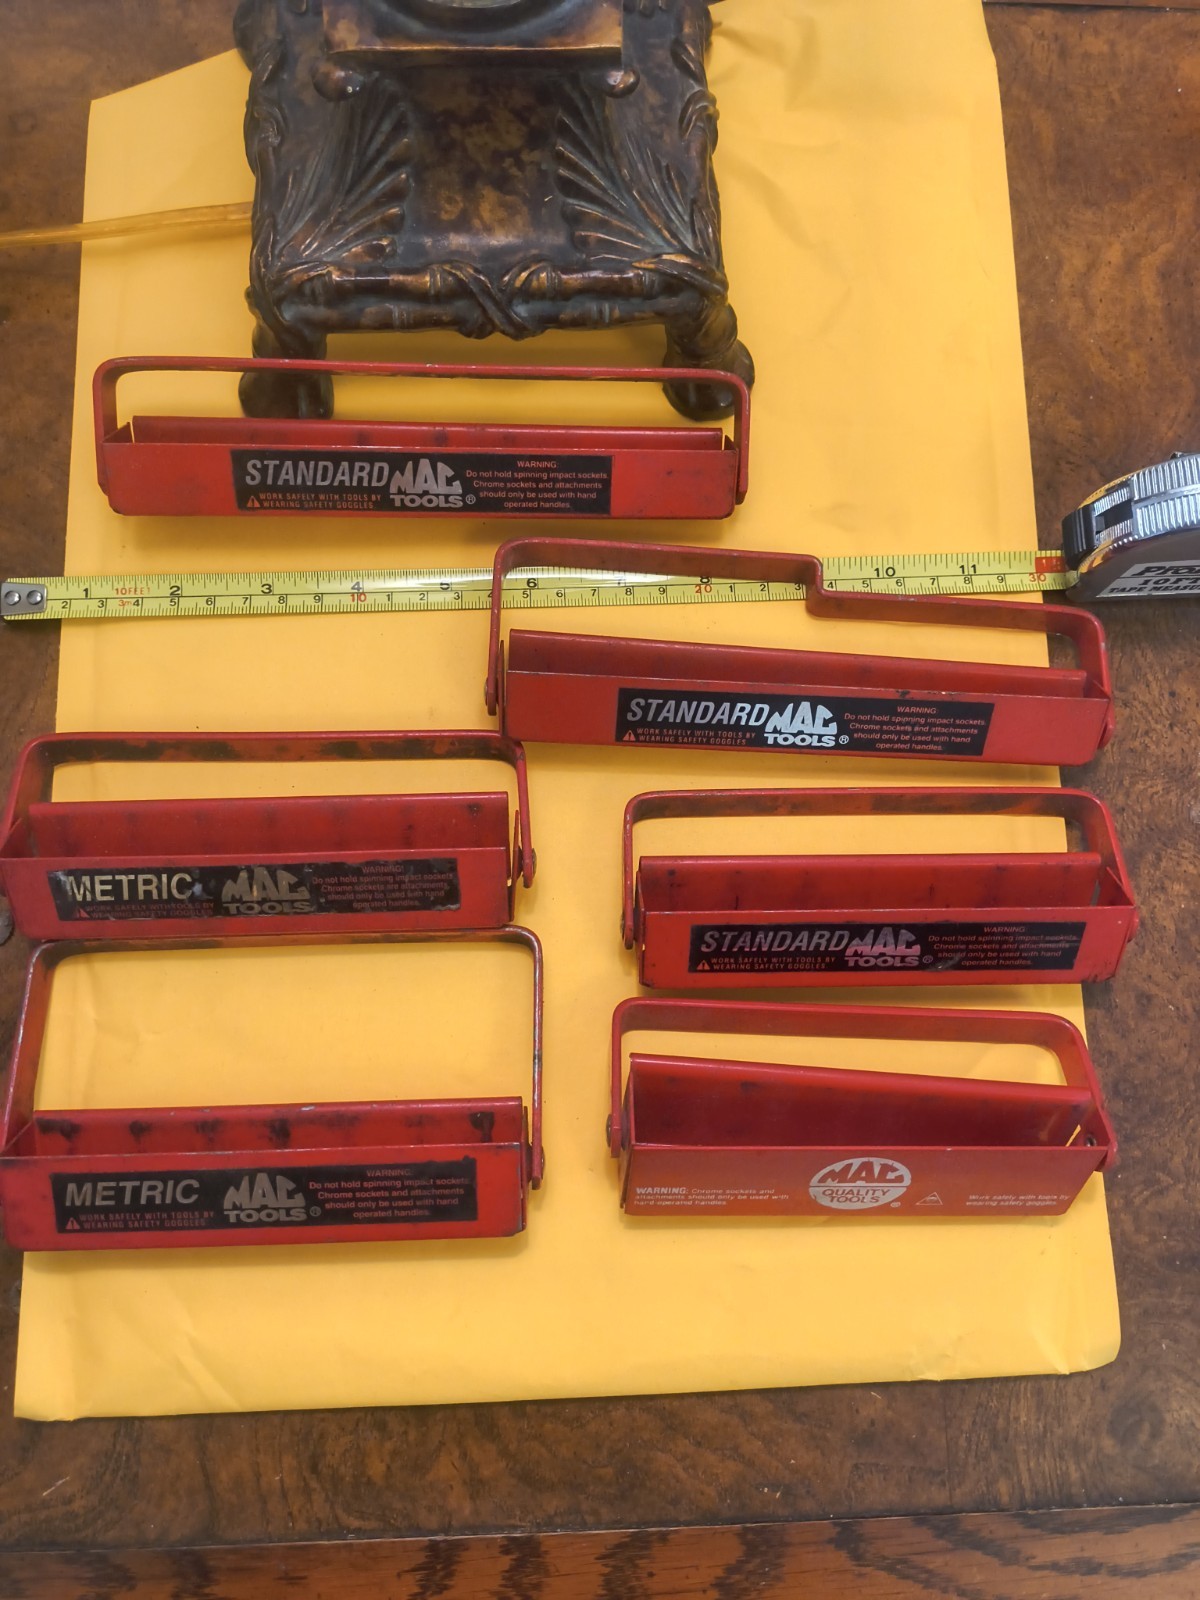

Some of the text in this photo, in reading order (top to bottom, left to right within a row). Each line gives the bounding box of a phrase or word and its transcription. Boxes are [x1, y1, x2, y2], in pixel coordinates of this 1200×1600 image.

[245, 459, 390, 487] STANDARD
[390, 458, 463, 494] MAC
[466, 470, 477, 478] Do
[494, 470, 512, 478] hold
[514, 471, 547, 480] spinning
[550, 471, 576, 480] impact
[473, 480, 504, 488] Chrome
[506, 481, 536, 489] sockets
[555, 481, 602, 489] attachments
[286, 493, 315, 501] SAFELY
[390, 493, 463, 508] TOOLS
[508, 491, 524, 500] only
[538, 491, 557, 499] used
[263, 500, 300, 508] WEARING
[303, 501, 334, 509] SAFETY
[504, 501, 538, 509] operated
[83, 588, 89, 598] 1
[169, 585, 181, 596] 2
[261, 583, 273, 594] 3
[351, 581, 362, 592] 4
[527, 578, 538, 588] 6
[133, 599, 140, 607] 4
[169, 598, 177, 607] 5
[205, 597, 214, 606] 6
[242, 597, 249, 606] 7
[278, 595, 286, 604] 8
[313, 594, 322, 604] 9
[350, 593, 367, 602] 10
[386, 593, 391, 602] 1
[419, 592, 427, 601] 2
[453, 591, 461, 600] 3
[522, 590, 530, 599] 5
[556, 590, 564, 598] 6
[590, 589, 597, 597] 7
[625, 588, 633, 596] 8
[658, 586, 666, 595] 9
[694, 585, 712, 594] 20
[729, 585, 734, 593] 1
[760, 583, 767, 592] 2
[827, 581, 834, 589] 4
[862, 578, 869, 588] 5
[896, 578, 903, 587] 6
[930, 577, 936, 586] 7
[963, 576, 970, 585] 8
[996, 575, 1004, 584] 9
[1028, 573, 1046, 582] 30
[61, 599, 105, 609] 2 3
[626, 697, 770, 727] STANDARD
[765, 701, 837, 734] MAC
[872, 714, 889, 722] hold
[891, 716, 925, 724] spinning
[663, 729, 692, 737] SAFELY
[718, 731, 743, 739] TOOLS
[850, 723, 881, 731] Chrome
[882, 724, 912, 732] sockets
[931, 726, 978, 734] attachments
[638, 735, 674, 743] WEARING
[678, 736, 707, 744] SAFETY
[764, 734, 835, 747] TOOLS
[853, 732, 880, 740] should
[875, 742, 910, 750] operated
[67, 873, 192, 902] METRIC
[222, 866, 310, 902] MAC
[223, 901, 311, 915] TOOLS
[701, 930, 850, 952] STANDARD
[845, 927, 920, 956] MAC
[711, 956, 735, 964] WORK
[844, 956, 919, 967] TOOLS
[817, 1160, 905, 1184] MAC
[223, 1172, 307, 1209] MAC
[309, 1181, 322, 1190] Do
[341, 1180, 360, 1188] hold
[363, 1180, 402, 1188] spinning
[65, 1179, 200, 1207] METRIC
[318, 1191, 353, 1200] Chrome
[355, 1190, 389, 1198] sockets
[391, 1189, 408, 1197] and
[822, 1188, 891, 1197] QUALITY
[324, 1201, 355, 1209] should
[357, 1200, 377, 1208] only
[392, 1199, 414, 1207] used
[828, 1195, 881, 1204] TOOLS
[223, 1208, 307, 1222] TOOLS
[353, 1210, 392, 1219] operated
